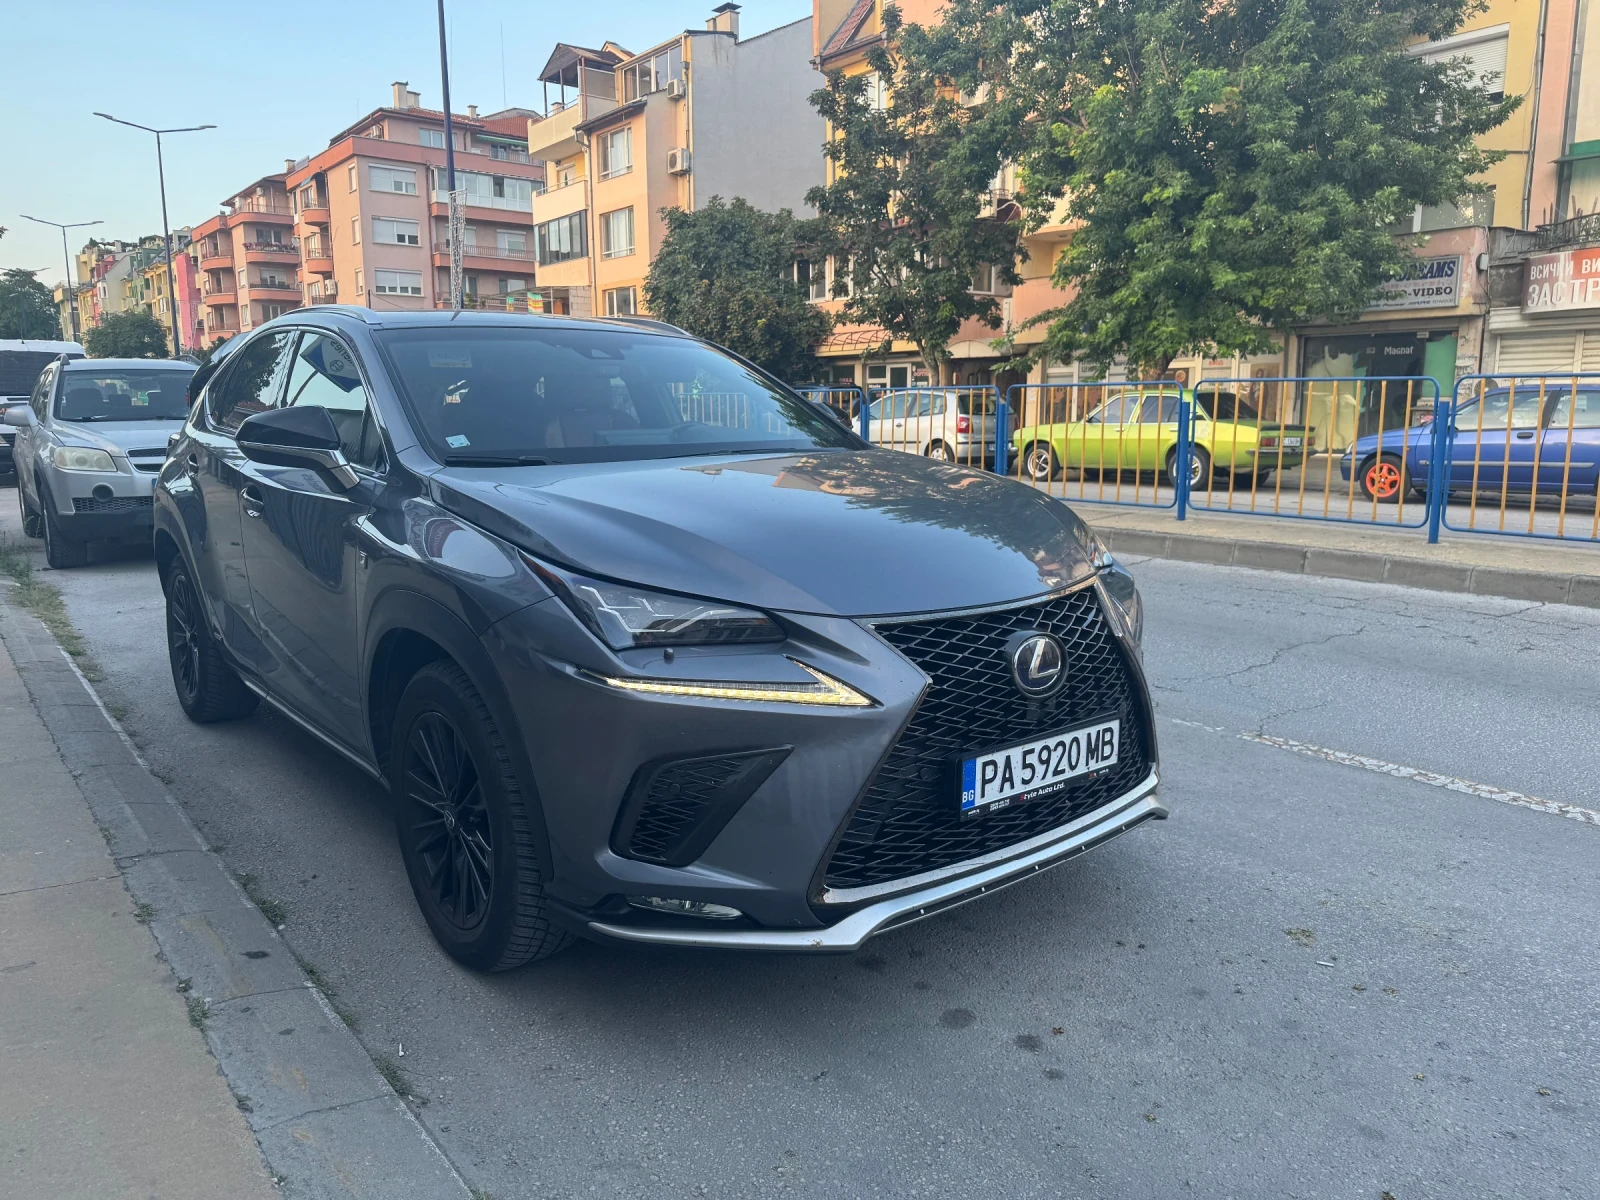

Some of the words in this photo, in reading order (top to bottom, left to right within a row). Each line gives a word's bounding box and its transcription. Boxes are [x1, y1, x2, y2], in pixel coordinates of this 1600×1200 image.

[1021, 736, 1081, 785] 5920
[962, 789, 975, 804] BG
[1020, 791, 1038, 801] Style
[1038, 786, 1054, 796] Auto
[1053, 782, 1066, 791] Ltd.
